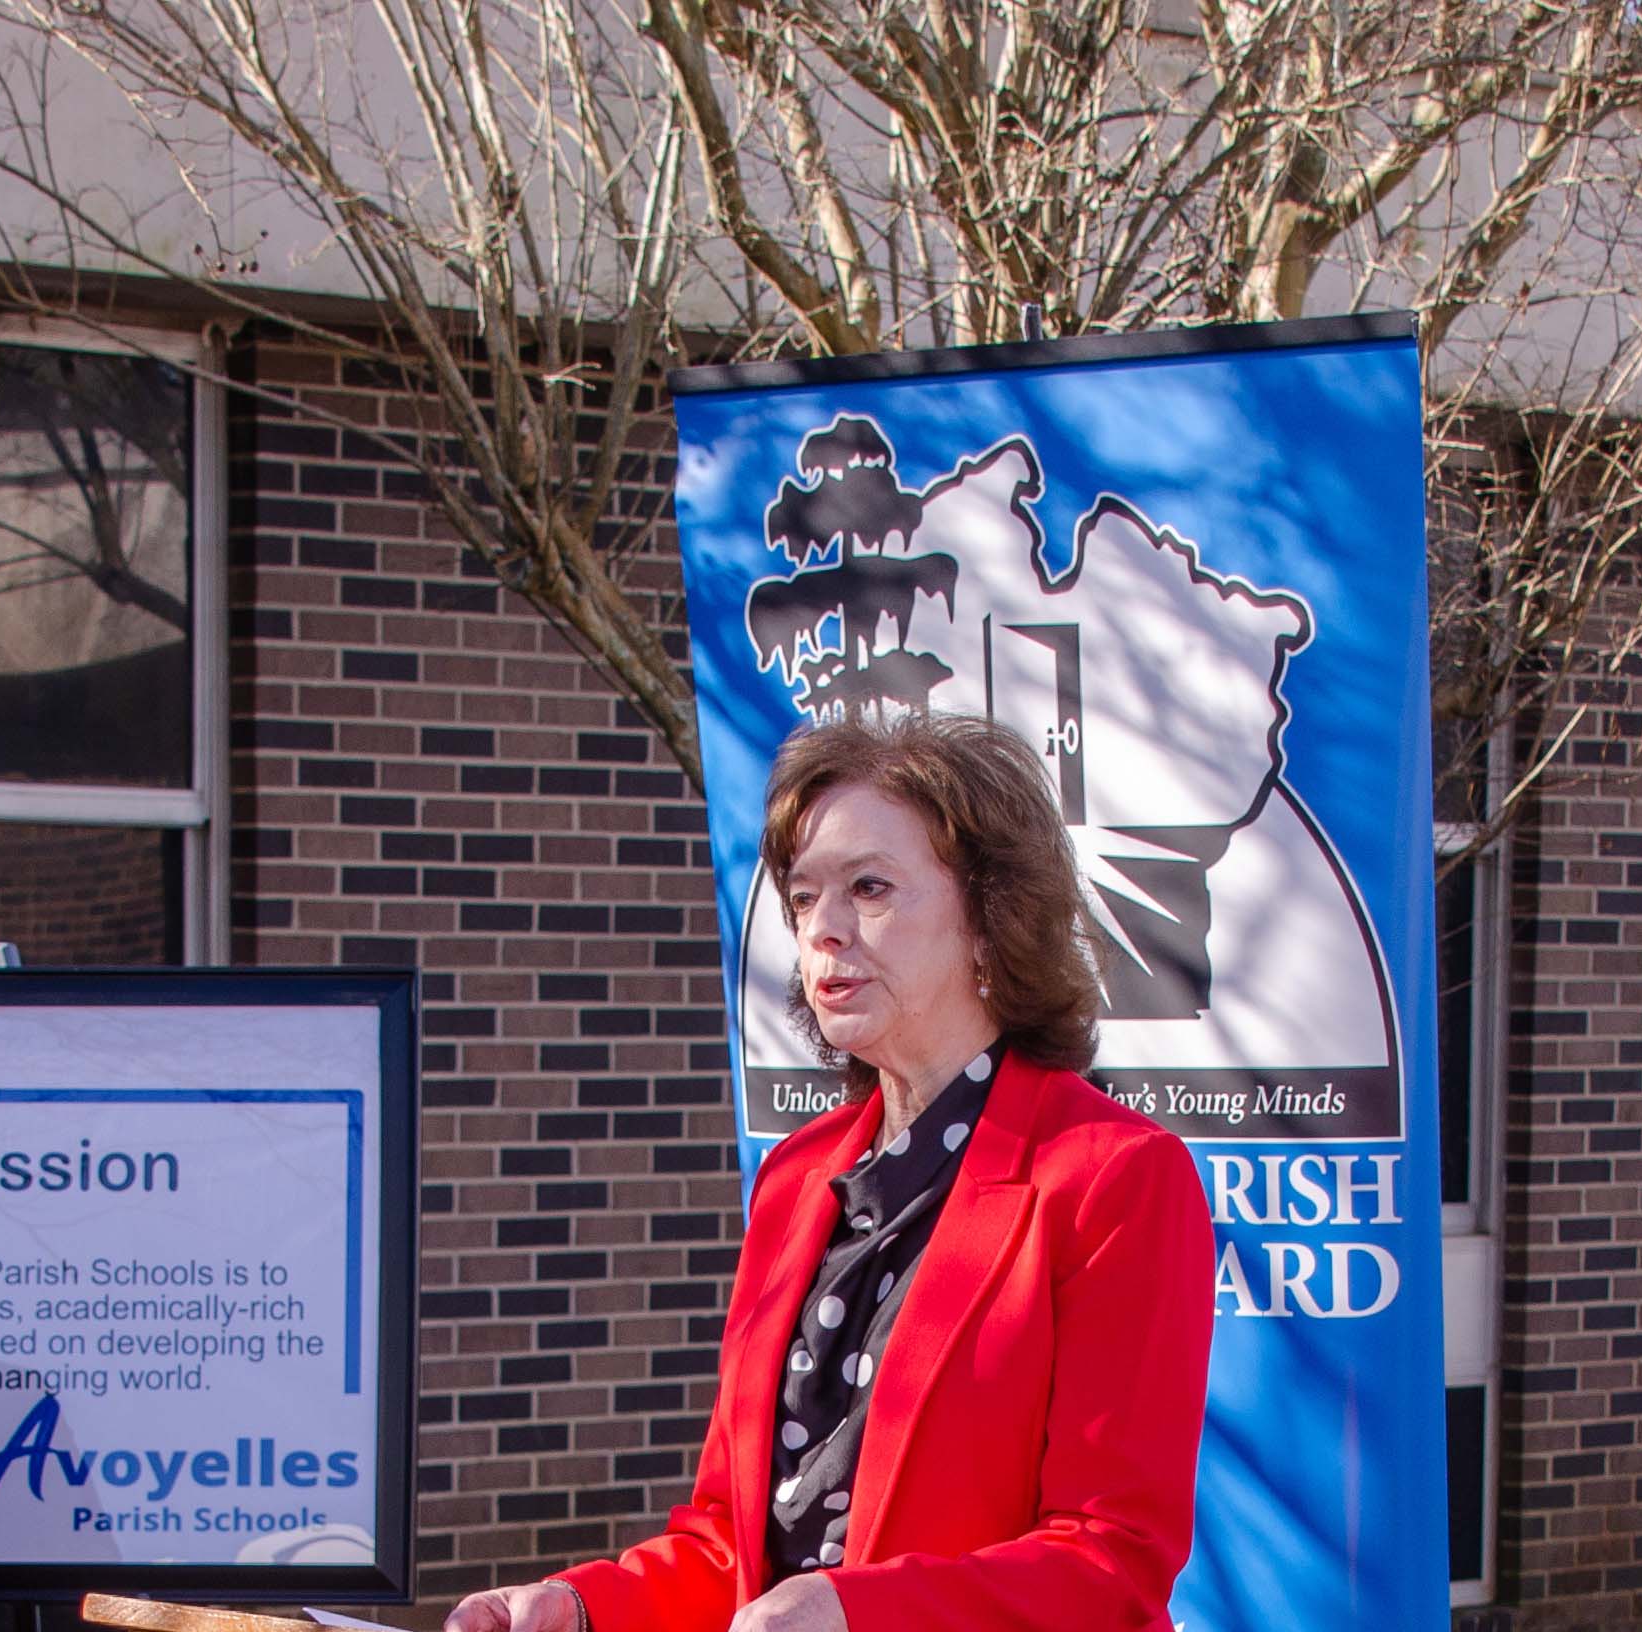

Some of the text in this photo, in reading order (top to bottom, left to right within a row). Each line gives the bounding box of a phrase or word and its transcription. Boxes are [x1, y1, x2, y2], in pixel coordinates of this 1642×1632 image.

[1165, 1085, 1247, 1124] Young
[1253, 1083, 1345, 1115] Minds
[1207, 1155, 1403, 1226] RISH
[91, 1258, 213, 1286] Schools
[225, 1260, 249, 1286] is
[260, 1261, 288, 1286] to
[1215, 1241, 1400, 1319] ARD
[35, 1294, 304, 1327] academically-rich
[48, 1333, 85, 1355] on
[97, 1329, 265, 1362] developing
[277, 1330, 324, 1356] the
[120, 1364, 210, 1390] world.
[72, 1508, 327, 1533] Parish Schools
